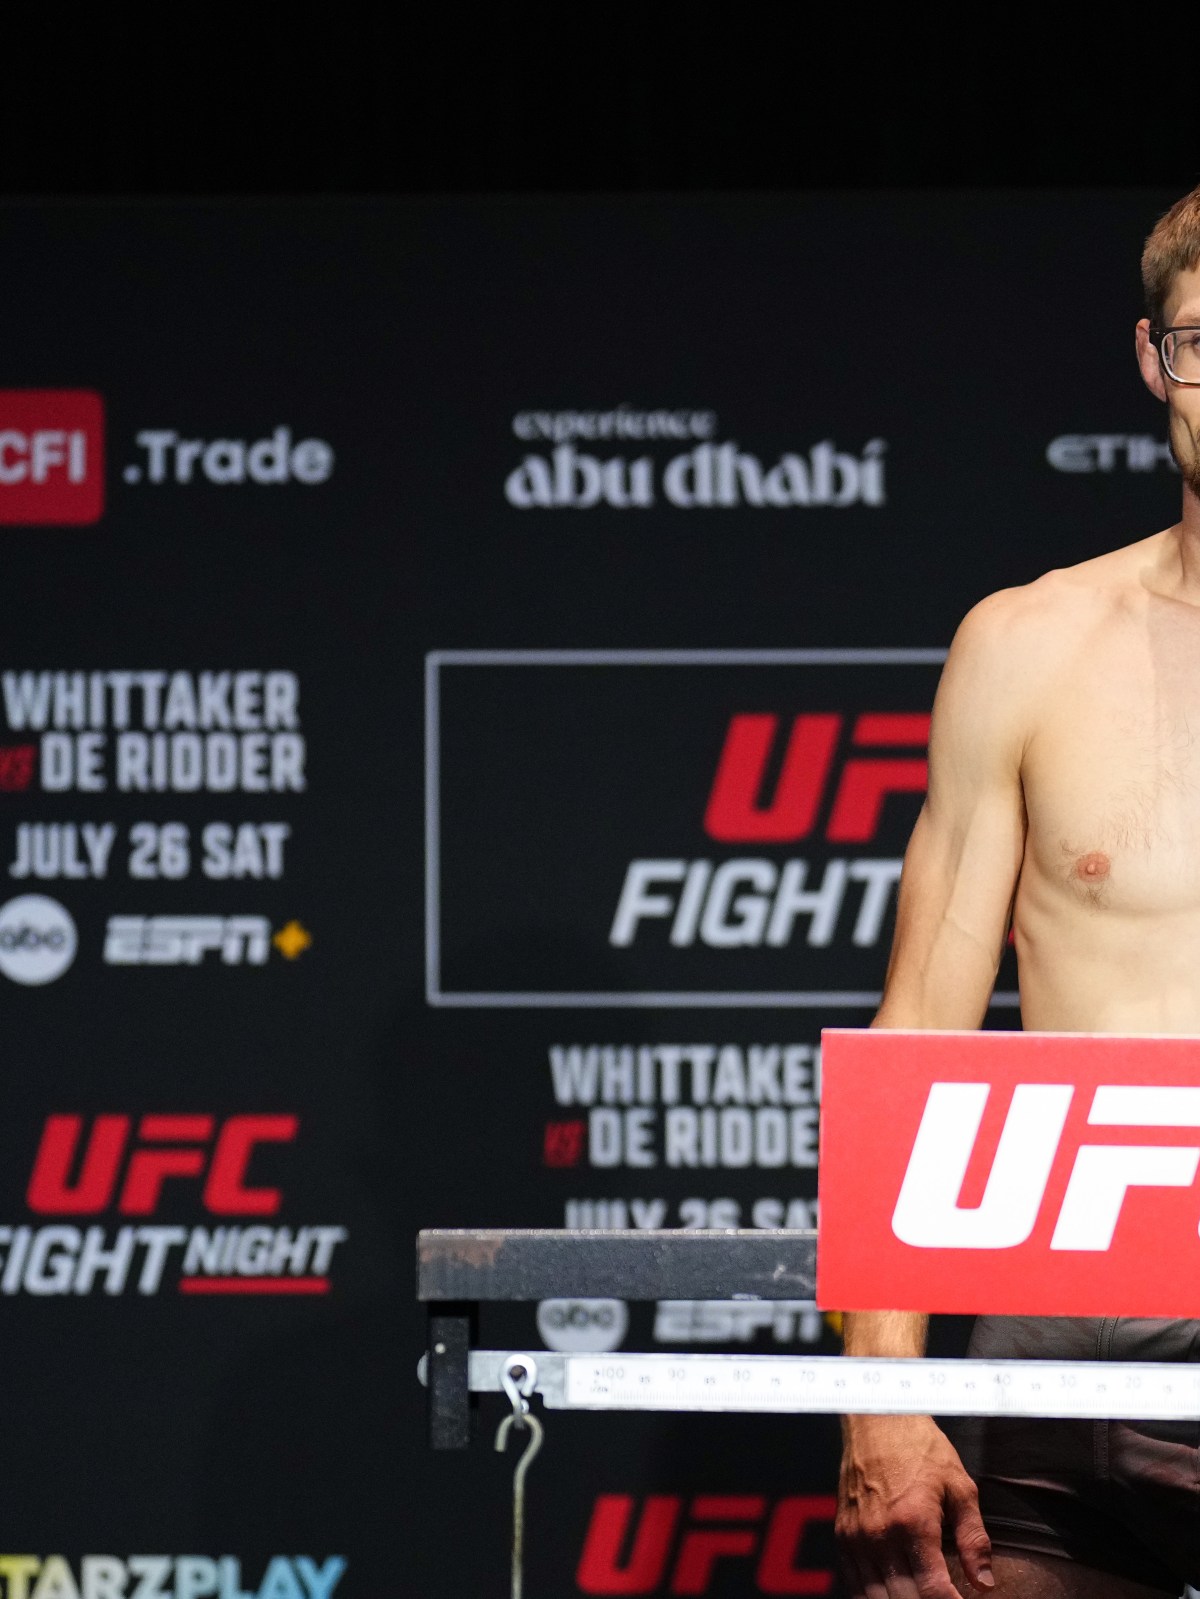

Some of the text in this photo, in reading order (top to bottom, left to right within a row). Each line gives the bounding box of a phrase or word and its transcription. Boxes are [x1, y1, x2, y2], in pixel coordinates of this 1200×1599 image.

[0, 426, 333, 485] CFI .Trade
[505, 437, 886, 508] abu dhabi
[1046, 434, 1182, 473] ETIH
[3, 670, 299, 730] WHITTAKER
[41, 735, 105, 792] DE
[117, 734, 305, 792] RIDDER
[705, 713, 932, 844] UF
[10, 823, 289, 879] JULY 26 SAT
[609, 858, 903, 948] FIGHT
[550, 1044, 822, 1105] WHITTAKE
[28, 1114, 299, 1215] UFC
[589, 1108, 656, 1168] DE
[665, 1108, 819, 1168] RIDDE
[183, 1226, 347, 1275] NIGHT
[576, 1493, 838, 1596] UFC
[0, 1555, 347, 1599] TARZPLAY
